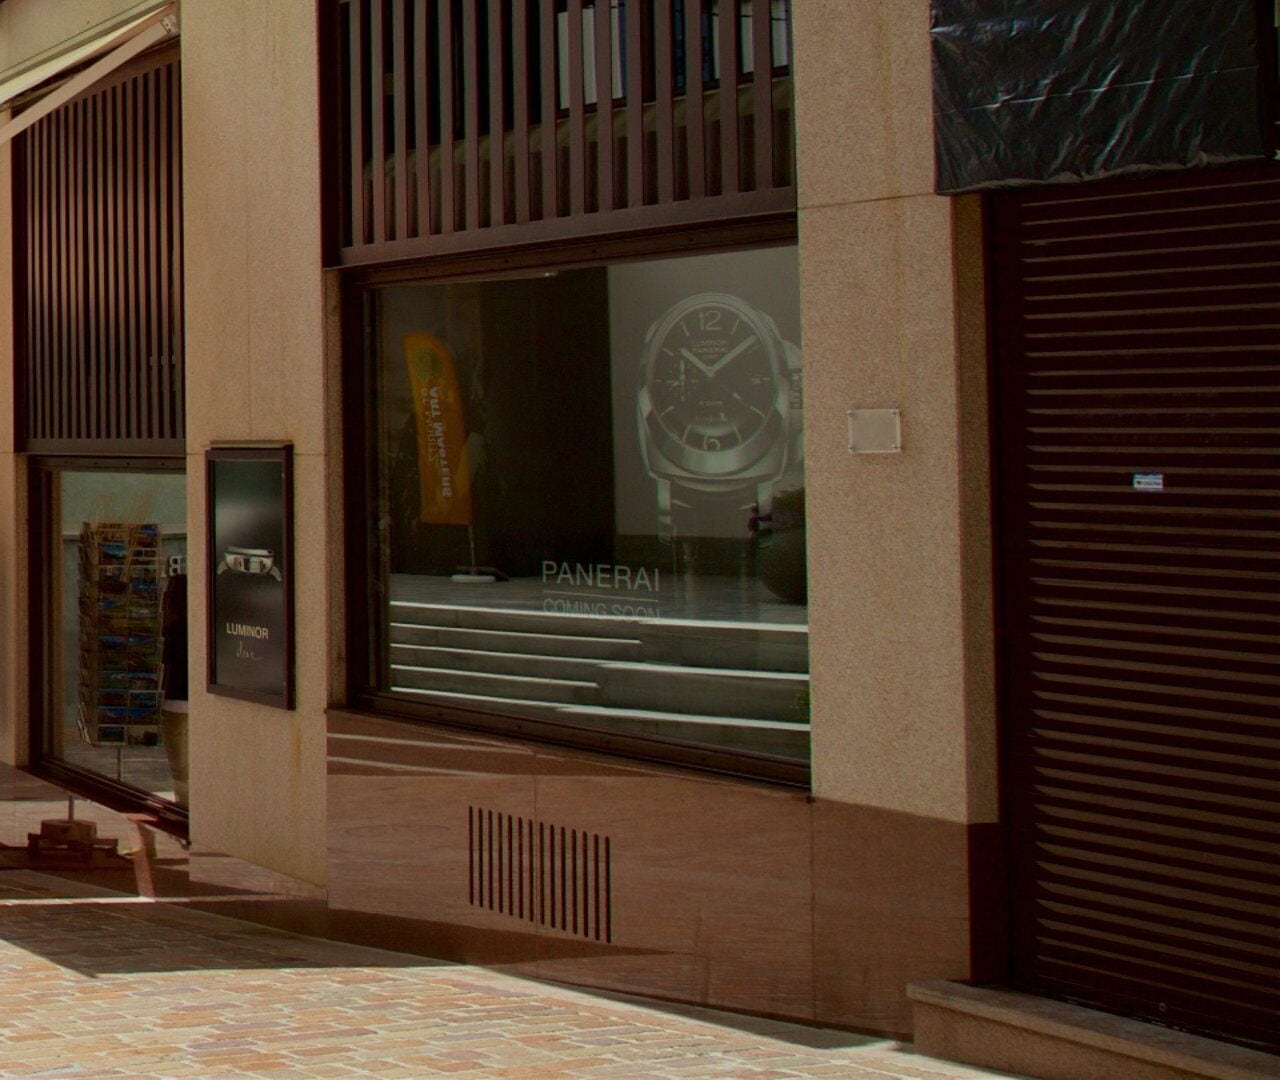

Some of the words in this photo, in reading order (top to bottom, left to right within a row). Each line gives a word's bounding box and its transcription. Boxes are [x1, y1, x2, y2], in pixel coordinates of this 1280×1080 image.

[542, 560, 660, 592] PANERAI
[543, 598, 608, 617] COMING
[226, 622, 269, 640] LUMINOR
